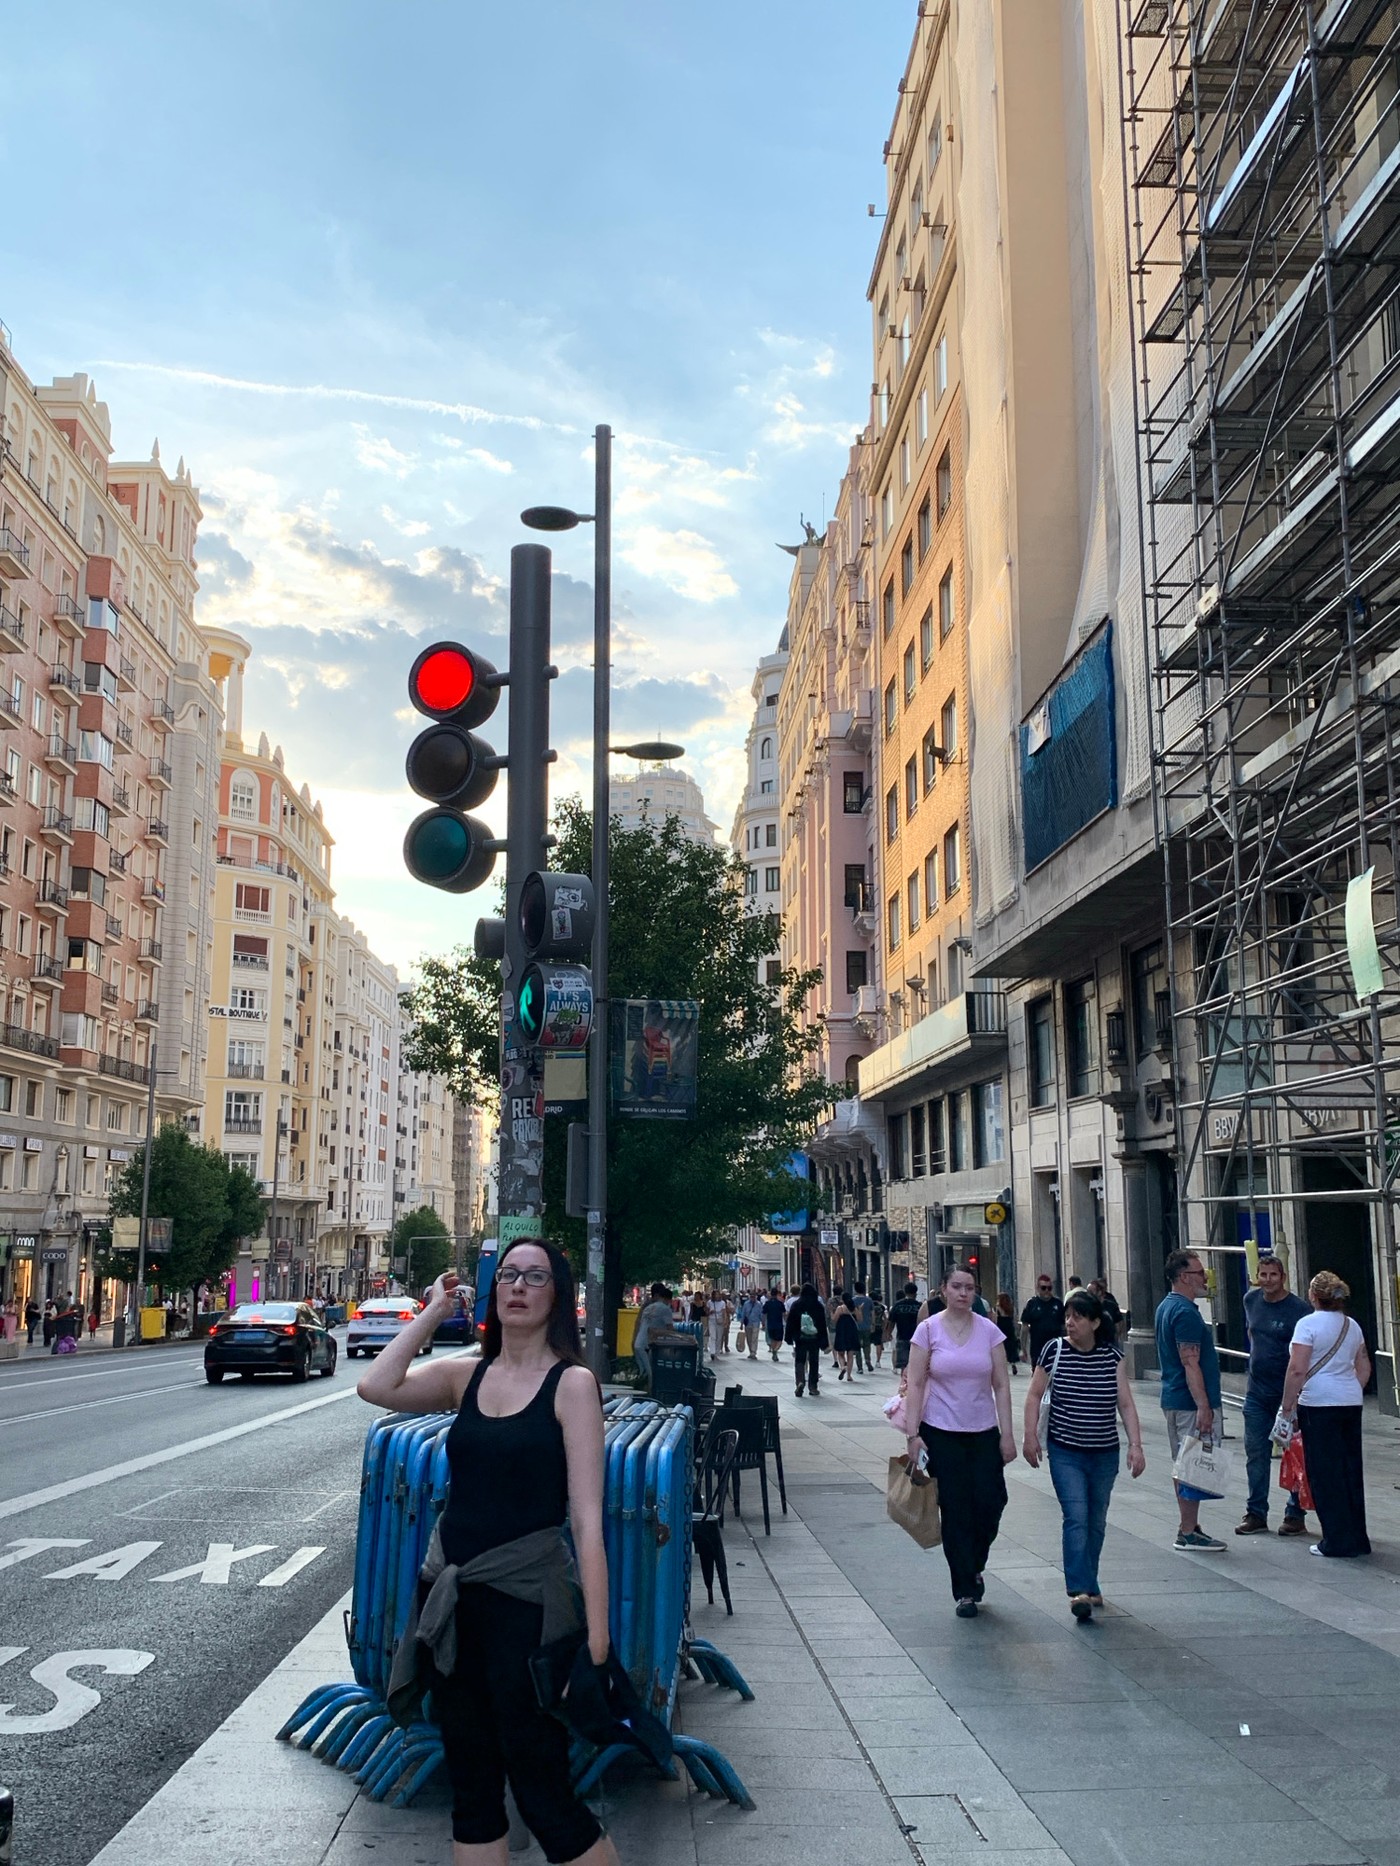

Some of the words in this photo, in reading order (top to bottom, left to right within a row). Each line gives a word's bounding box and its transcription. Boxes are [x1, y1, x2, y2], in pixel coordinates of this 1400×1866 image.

[558, 991, 580, 1001] IT'S
[549, 1001, 589, 1012] ALWAYS
[229, 1009, 260, 1019] BOUTIQUE
[544, 1106, 563, 1114] DRID
[503, 1222, 539, 1231] ALQUILO
[0, 1538, 327, 1586] TAXI
[0, 1647, 155, 1735] S
